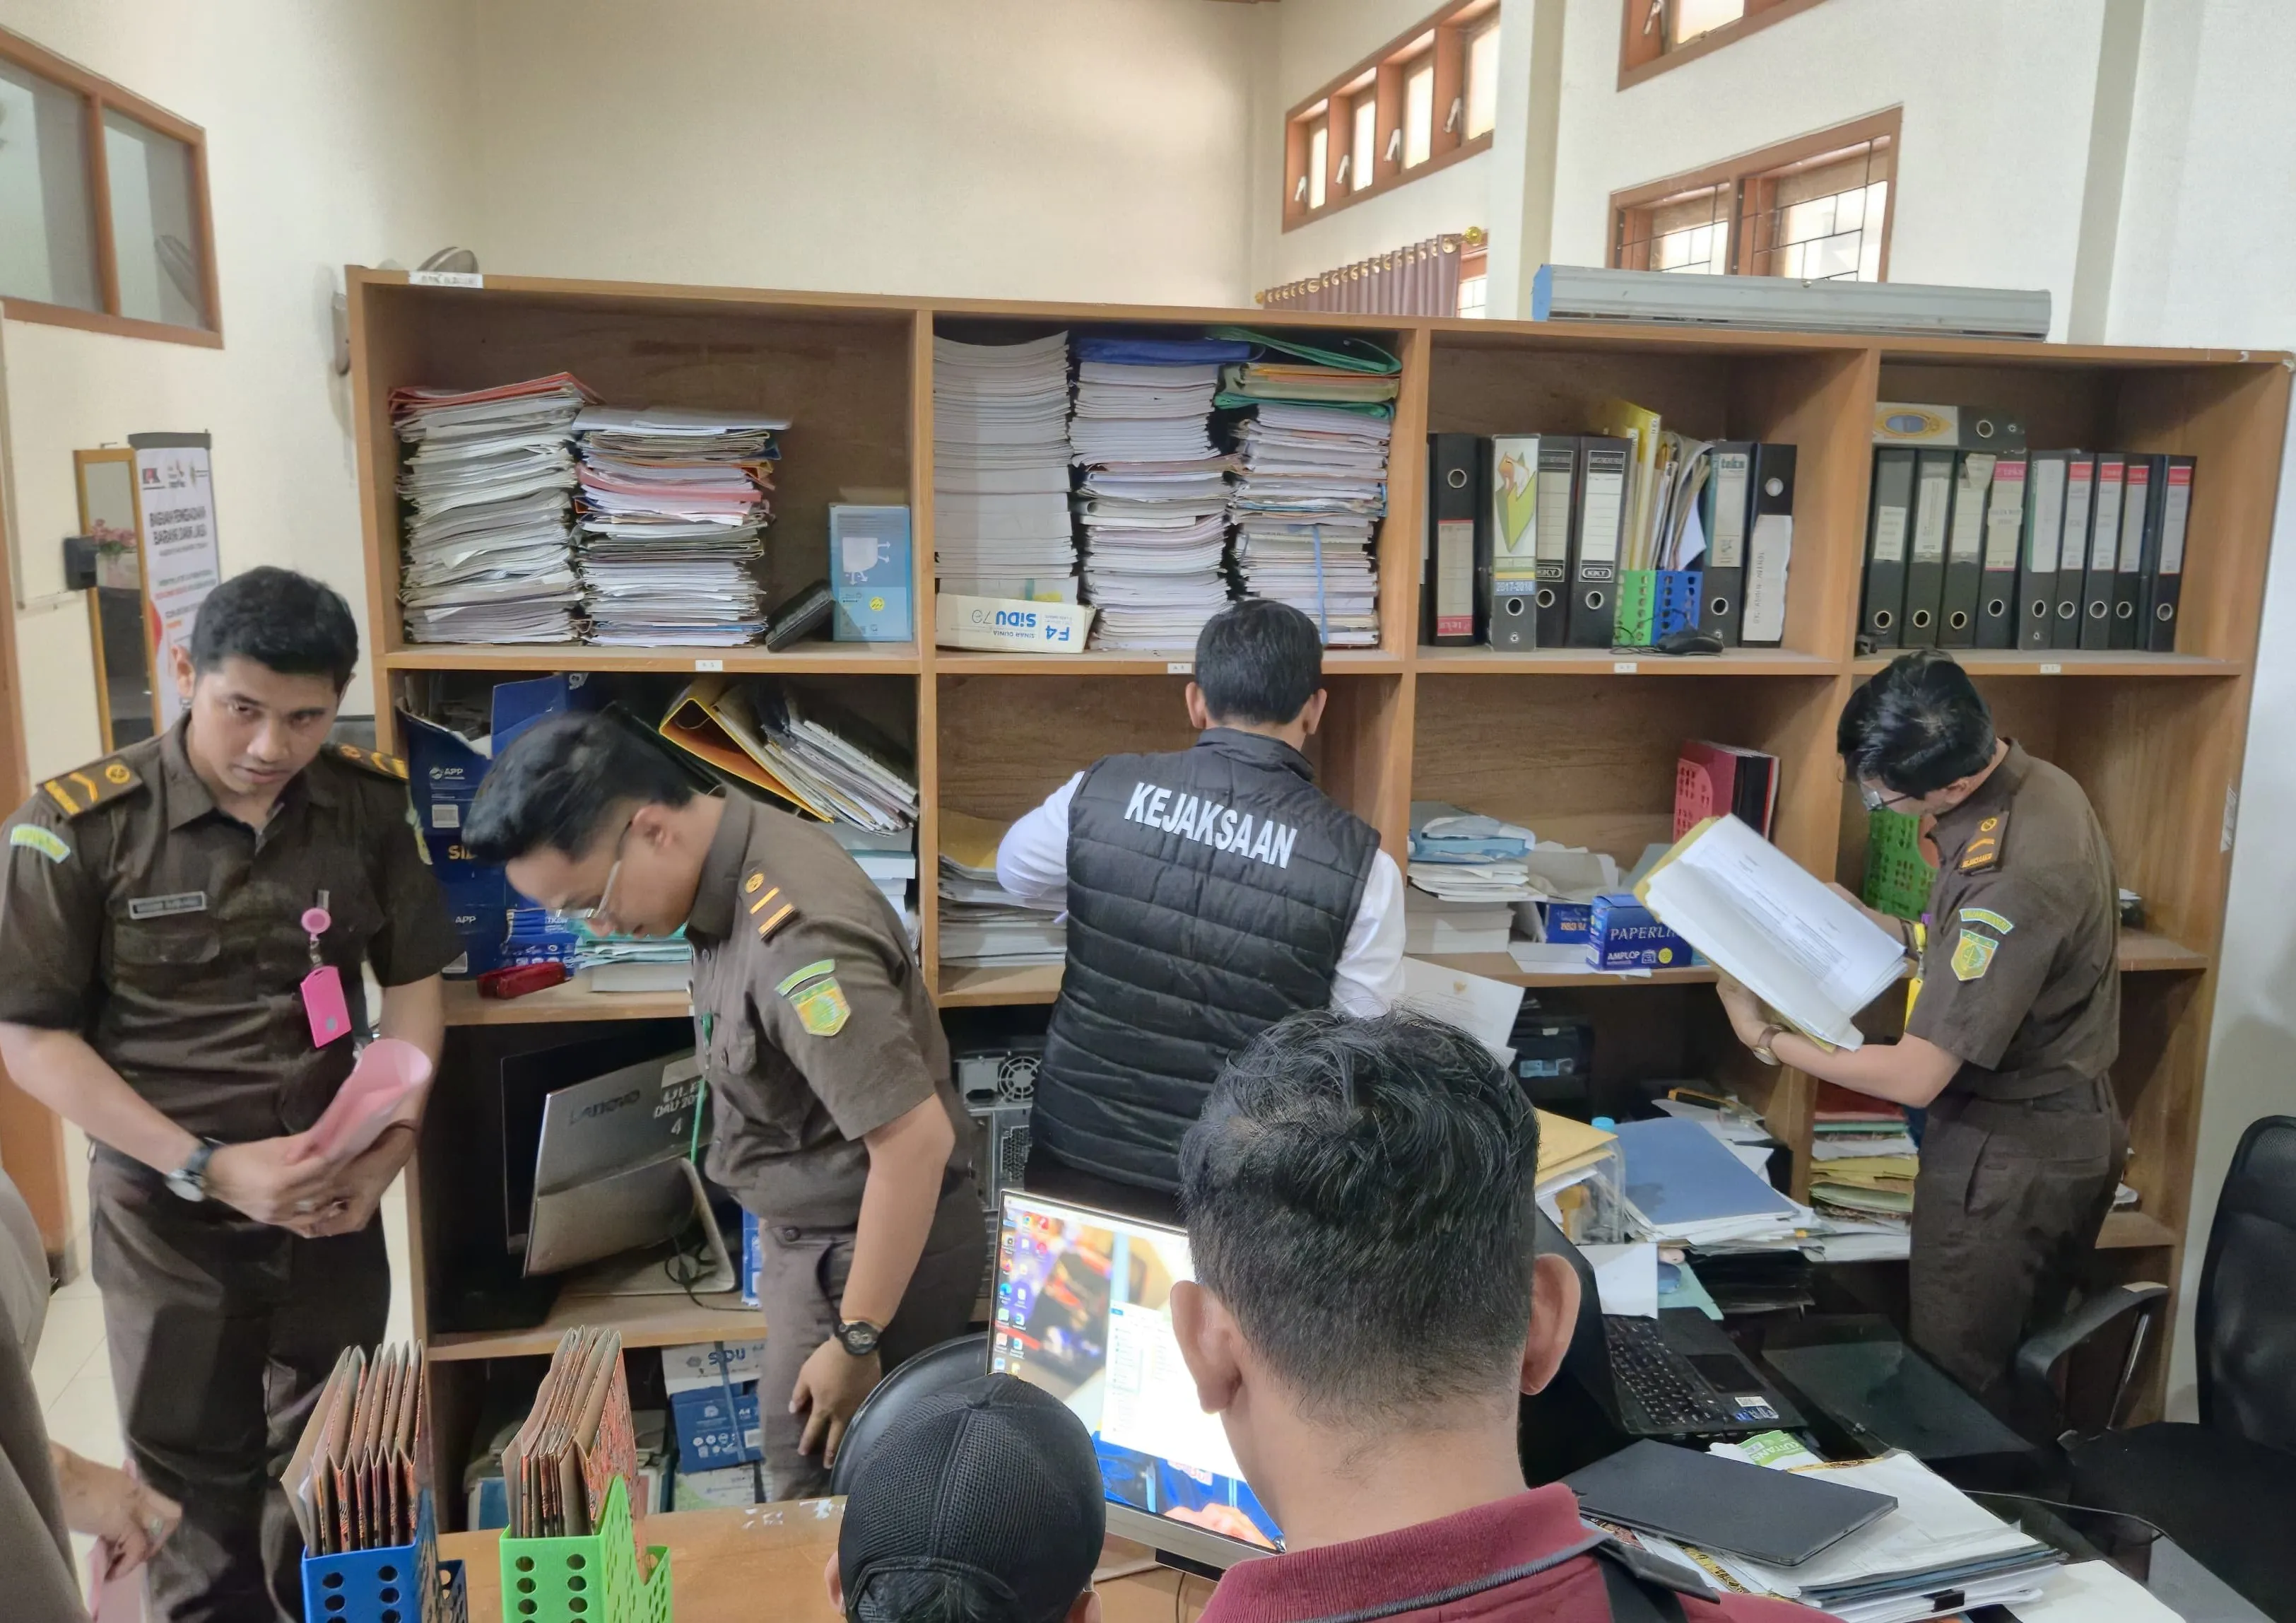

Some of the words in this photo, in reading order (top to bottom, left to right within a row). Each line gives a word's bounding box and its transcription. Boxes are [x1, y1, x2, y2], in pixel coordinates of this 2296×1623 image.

[1044, 625, 1070, 641] F4
[1124, 782, 1298, 869] KEJAKSAAN
[454, 915, 477, 925] APP
[671, 1117, 683, 1135] 4
